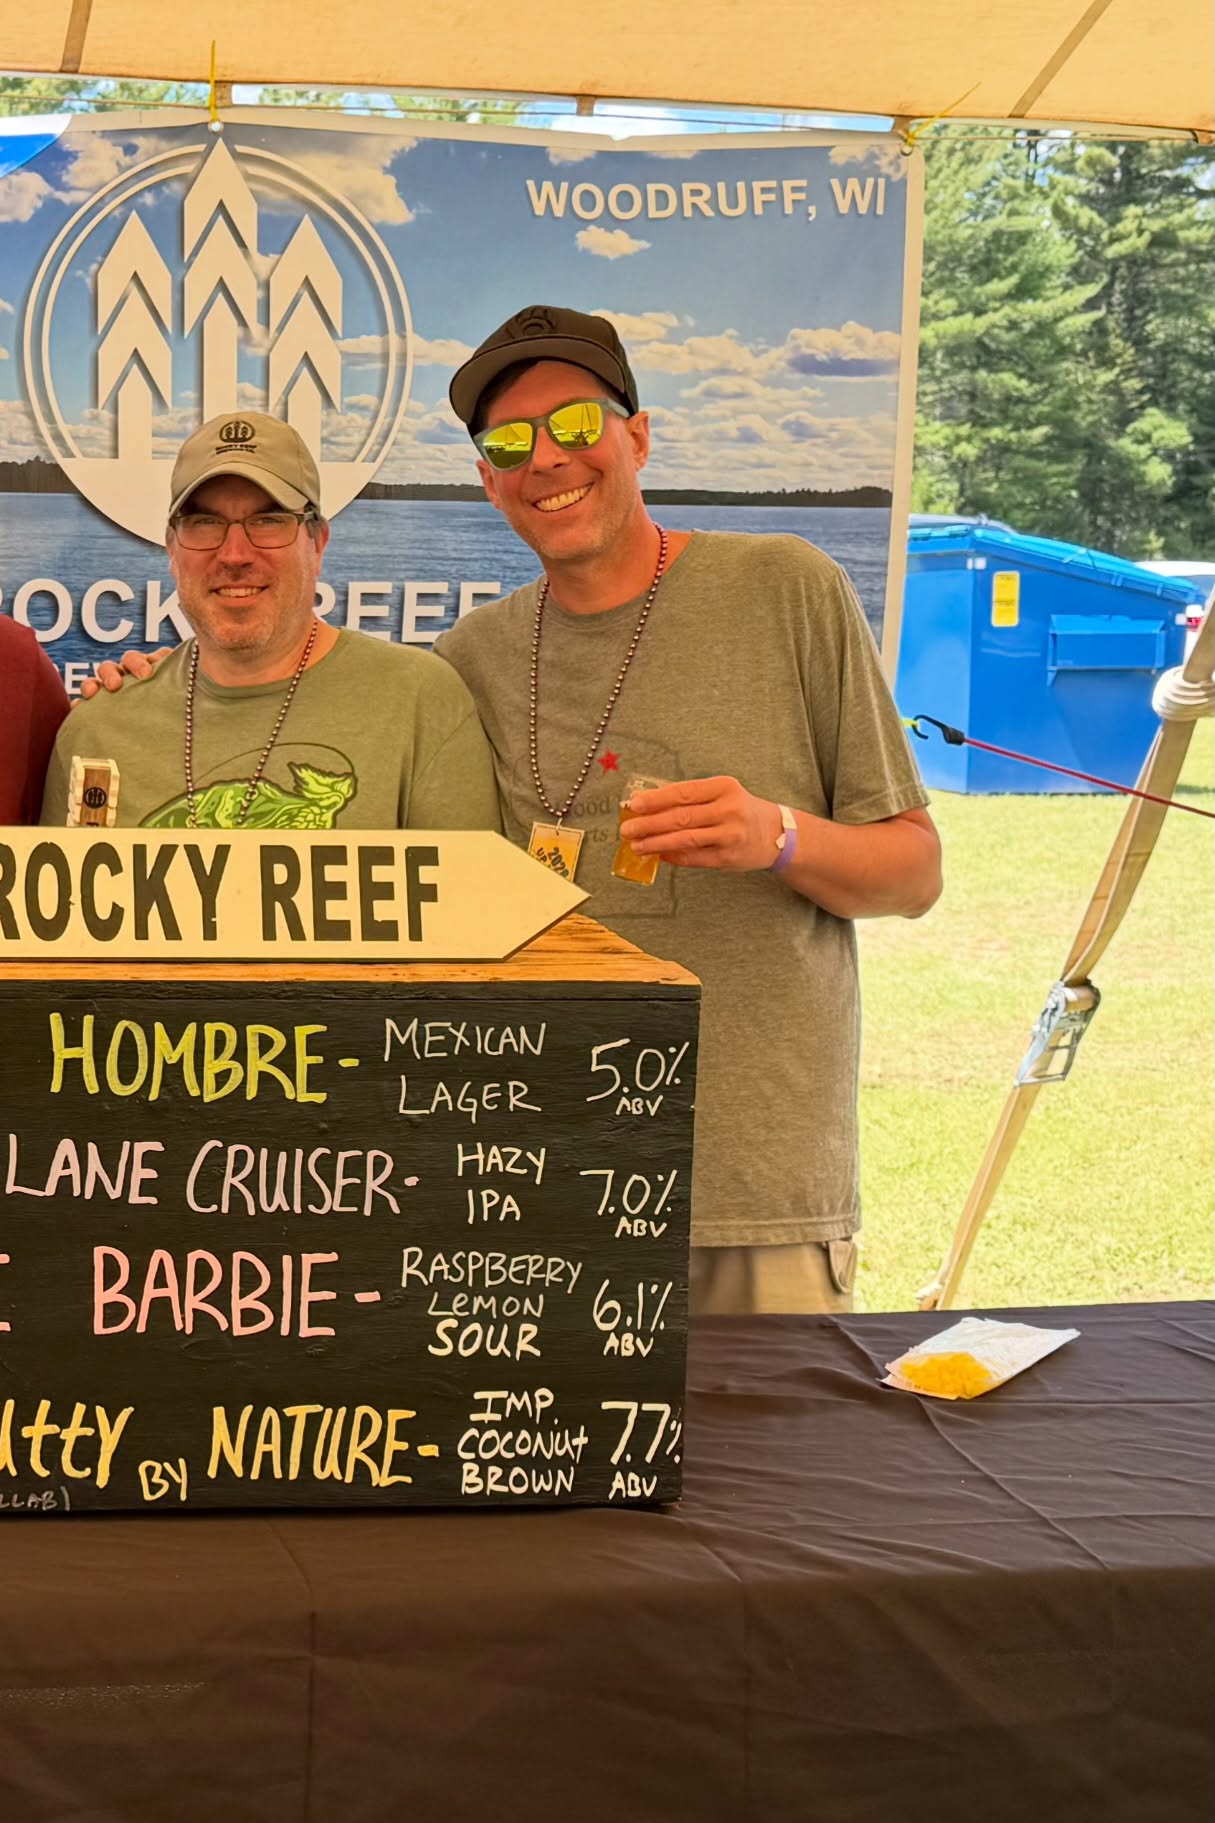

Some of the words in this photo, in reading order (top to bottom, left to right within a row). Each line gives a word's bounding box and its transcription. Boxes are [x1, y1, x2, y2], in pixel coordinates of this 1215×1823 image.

[526, 179, 817, 222] WOODRUFF,
[830, 177, 885, 216] WI
[259, 844, 439, 942] REEF
[384, 1017, 546, 1062] MEXICAN
[586, 1038, 689, 1102] 5.0%
[399, 1074, 542, 1124] LAGER
[615, 1095, 663, 1116] ABV
[5, 1133, 165, 1205] LANE
[457, 1142, 546, 1185] HAZY
[468, 1188, 521, 1224] IPA
[579, 1169, 677, 1216] 7.0%
[614, 1216, 667, 1238] ABV
[401, 1247, 582, 1293] RASPBERRY
[592, 1279, 673, 1332] 6.1%
[427, 1318, 541, 1361] SOUR
[603, 1332, 654, 1358] ABV
[601, 1400, 682, 1465] 7.7%
[138, 1457, 188, 1501] BY
[461, 1462, 574, 1496] BROWN
[608, 1471, 657, 1500] ABV
